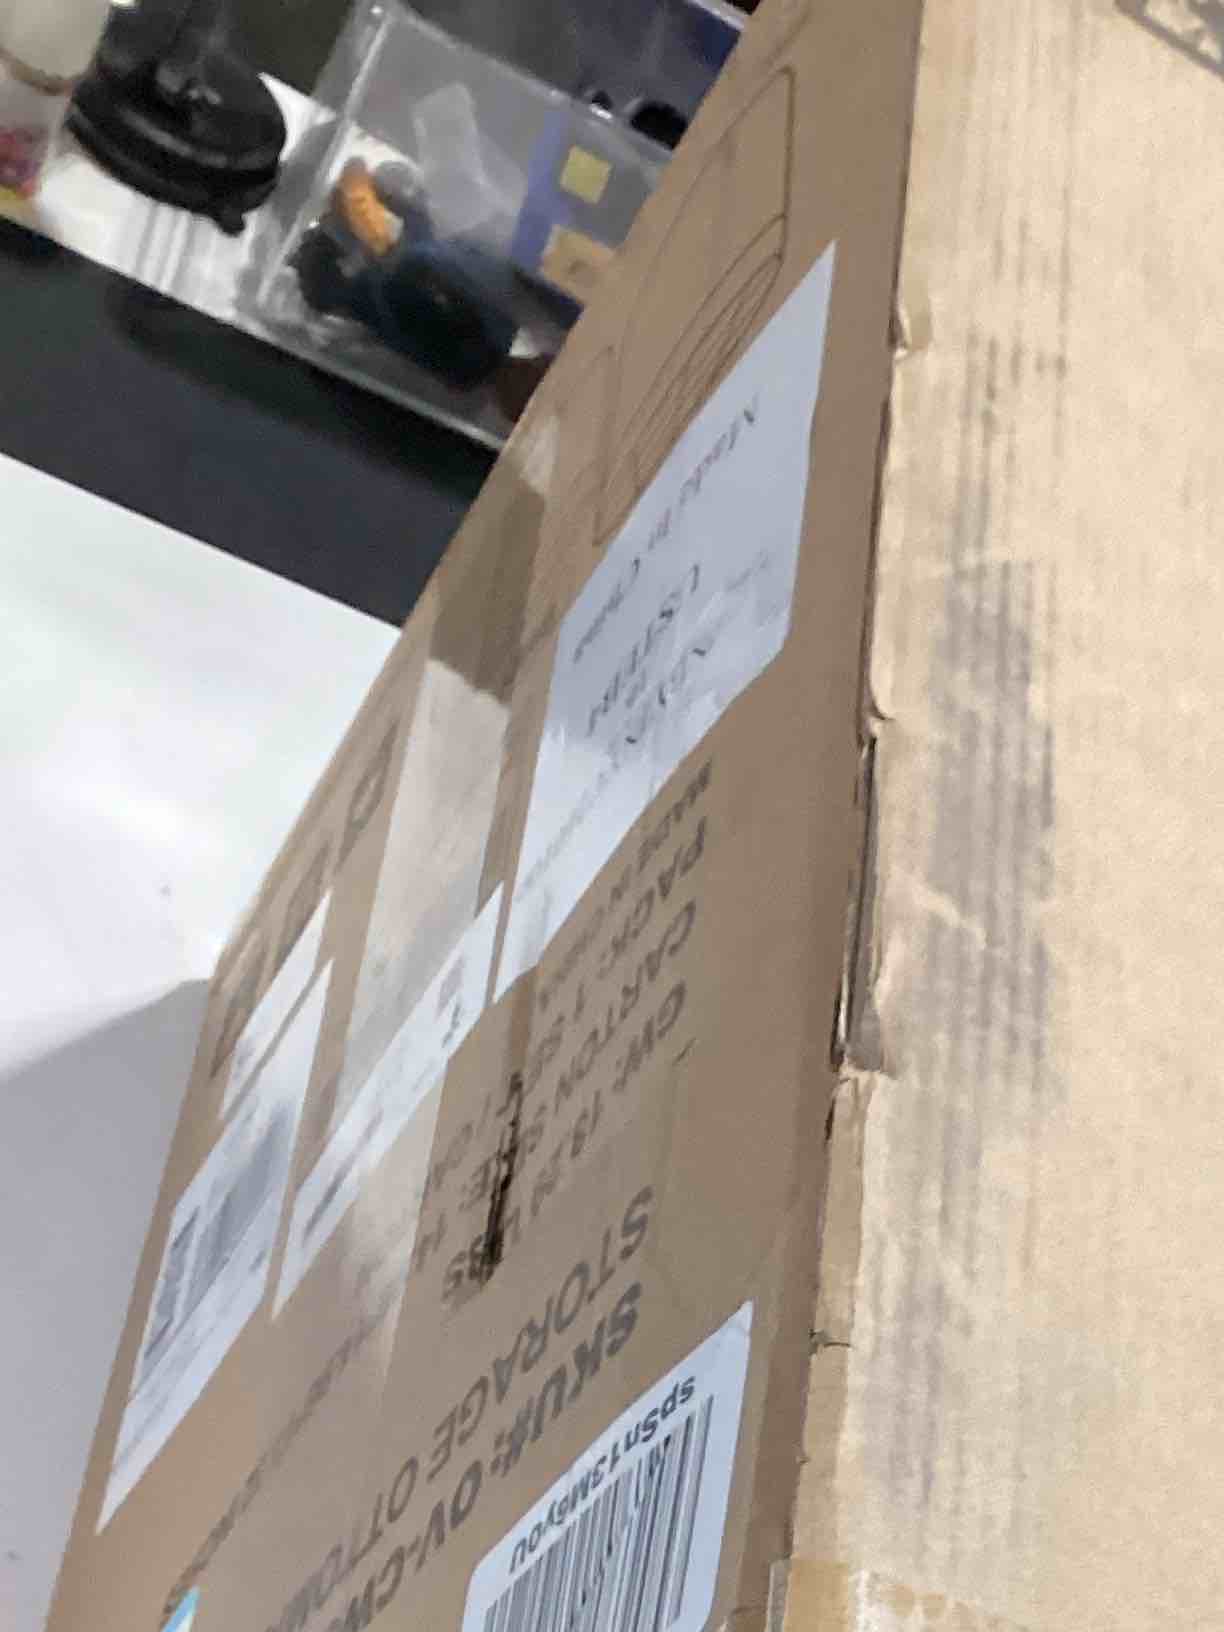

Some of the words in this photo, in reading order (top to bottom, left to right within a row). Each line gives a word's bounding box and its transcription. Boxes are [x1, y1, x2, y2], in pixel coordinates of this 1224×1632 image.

[551, 894, 697, 1116] CARTON
[428, 1183, 653, 1479] STORAGE
[489, 1279, 643, 1476] SKU#:
